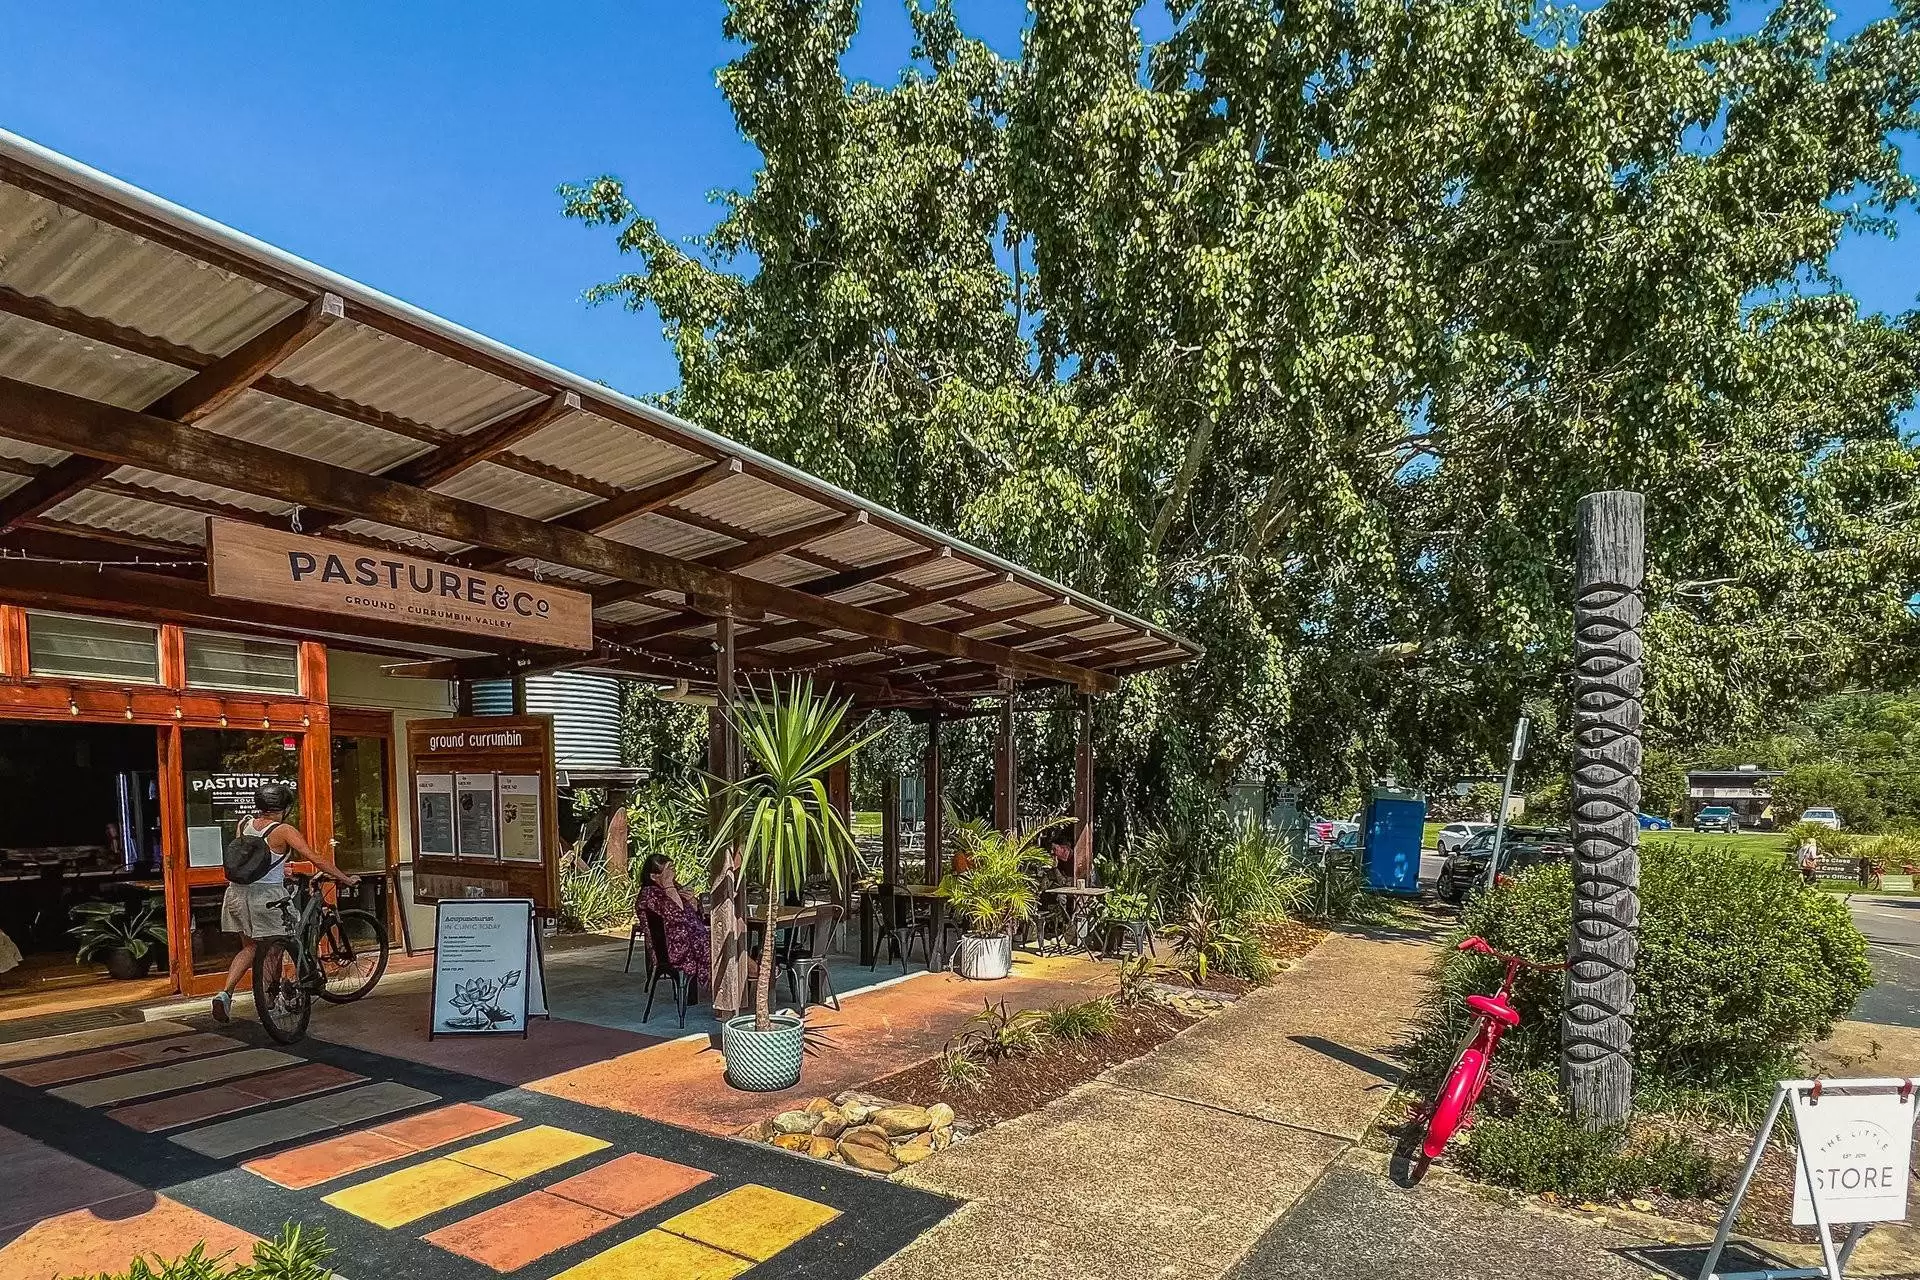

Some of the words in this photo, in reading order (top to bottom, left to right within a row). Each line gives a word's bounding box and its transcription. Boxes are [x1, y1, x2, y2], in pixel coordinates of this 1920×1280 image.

[345, 595, 396, 610] GROUND
[407, 605, 472, 623] CURRUMBIN
[475, 616, 512, 628] VALLEY
[430, 733, 464, 751] ground
[469, 730, 522, 747] currumbin
[1820, 1134, 1842, 1153] THE
[1851, 1130, 1889, 1152] LITTLE
[1815, 1166, 1893, 1190] STORE
